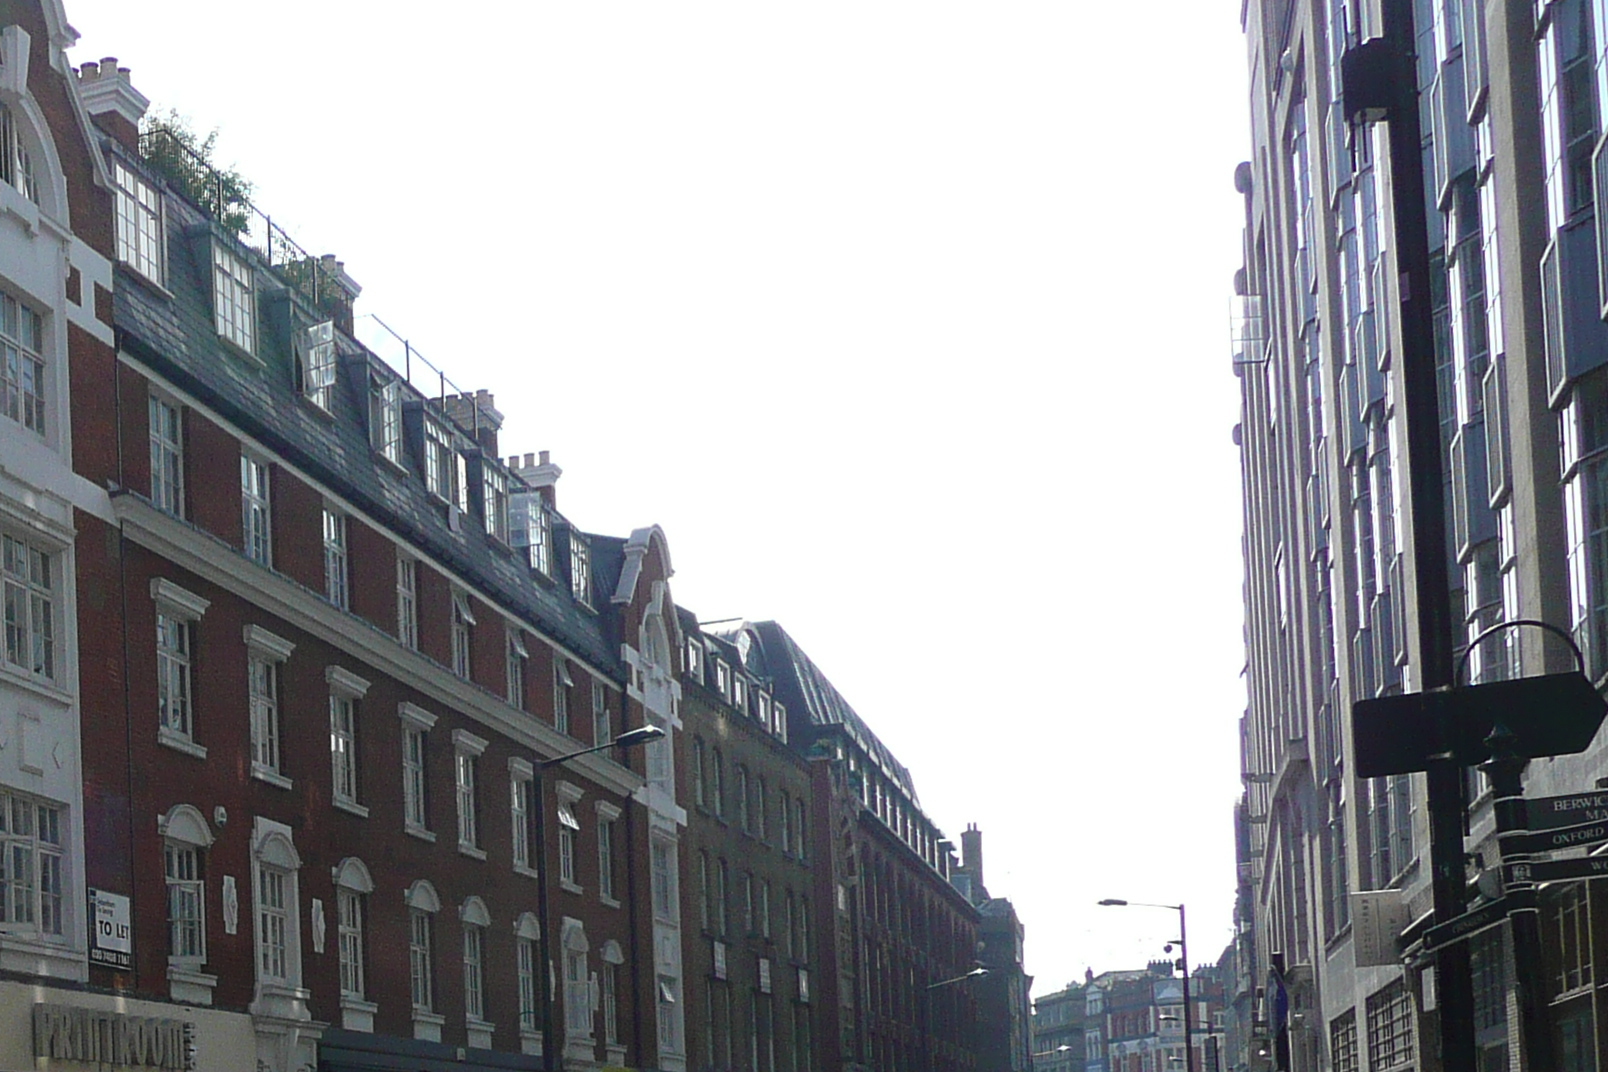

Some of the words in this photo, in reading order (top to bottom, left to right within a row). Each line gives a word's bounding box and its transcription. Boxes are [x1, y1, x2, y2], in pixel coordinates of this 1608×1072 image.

[1553, 795, 1608, 811] BERWIC
[1586, 808, 1608, 821] MA
[1553, 826, 1605, 845] OXFORD
[99, 919, 112, 936] TO
[116, 922, 129, 940] LET
